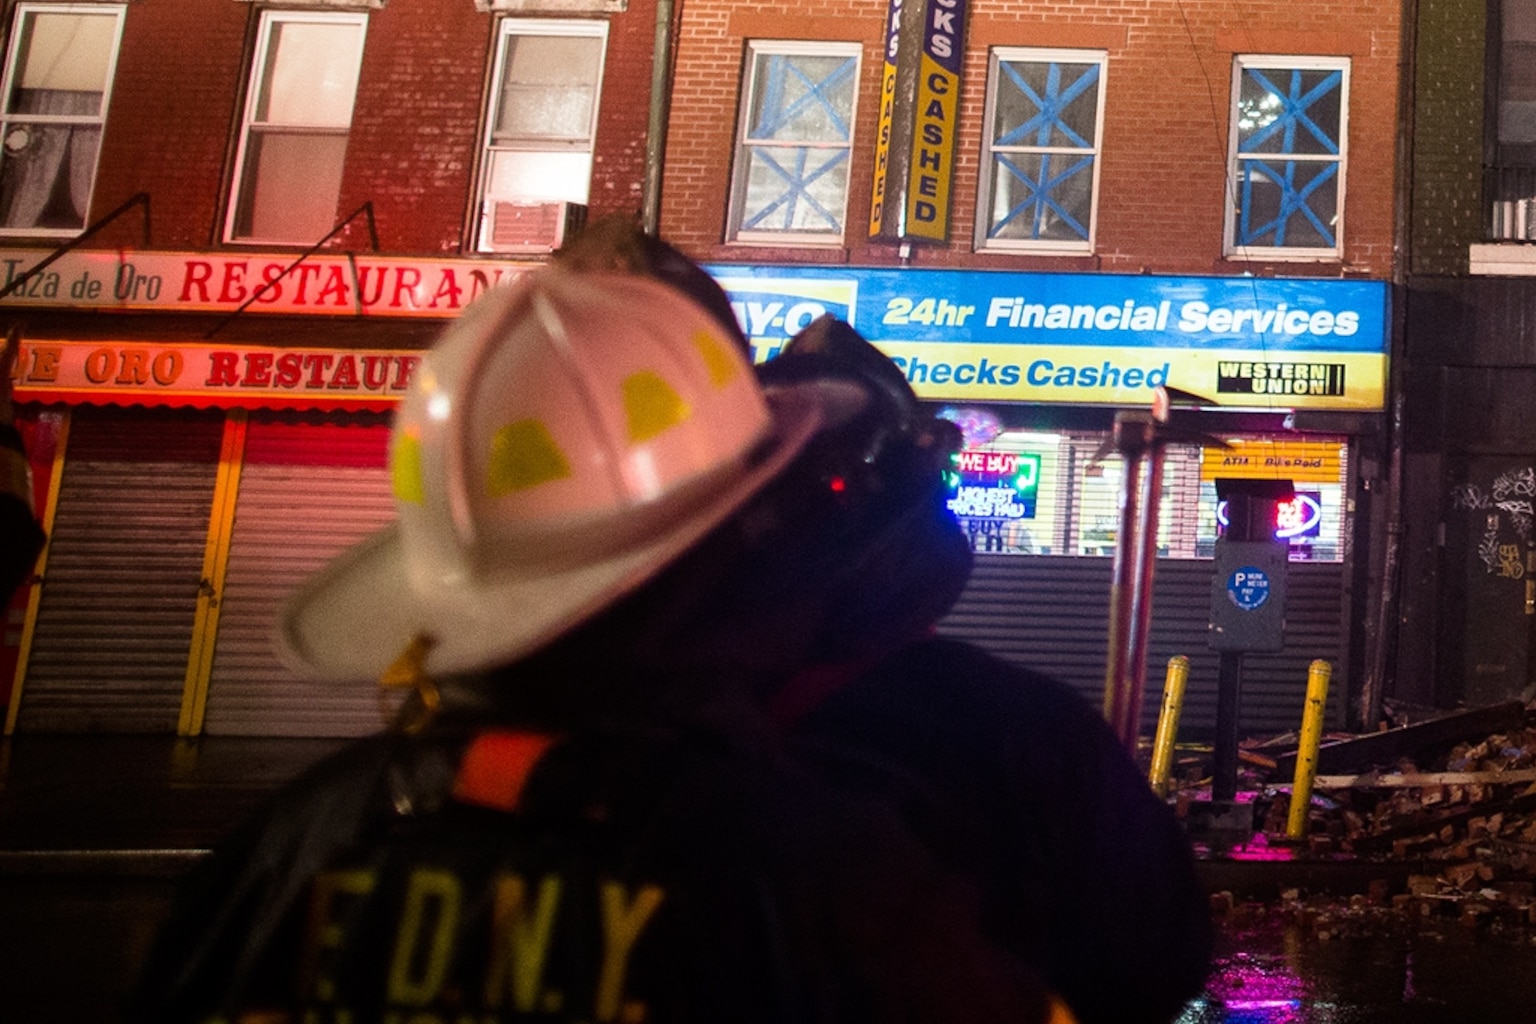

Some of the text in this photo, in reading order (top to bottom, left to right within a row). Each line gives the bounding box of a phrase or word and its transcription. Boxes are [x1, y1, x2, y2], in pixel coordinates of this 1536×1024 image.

[873, 73, 896, 224] CASHED
[914, 72, 949, 225] CASHED
[70, 271, 102, 300] de
[113, 262, 163, 301] Oro
[177, 260, 508, 308] RESTAURAN
[882, 296, 1360, 337] 24hr Financial Services
[84, 346, 185, 386] ORO
[204, 351, 424, 391] RESTAUR
[1026, 358, 1171, 389] Cashed
[1219, 362, 1326, 380] WESTERN
[1251, 378, 1326, 395] UNION
[959, 453, 1019, 473] WE BUY
[1222, 456, 1250, 467] ATM
[1234, 572, 1246, 588] P
